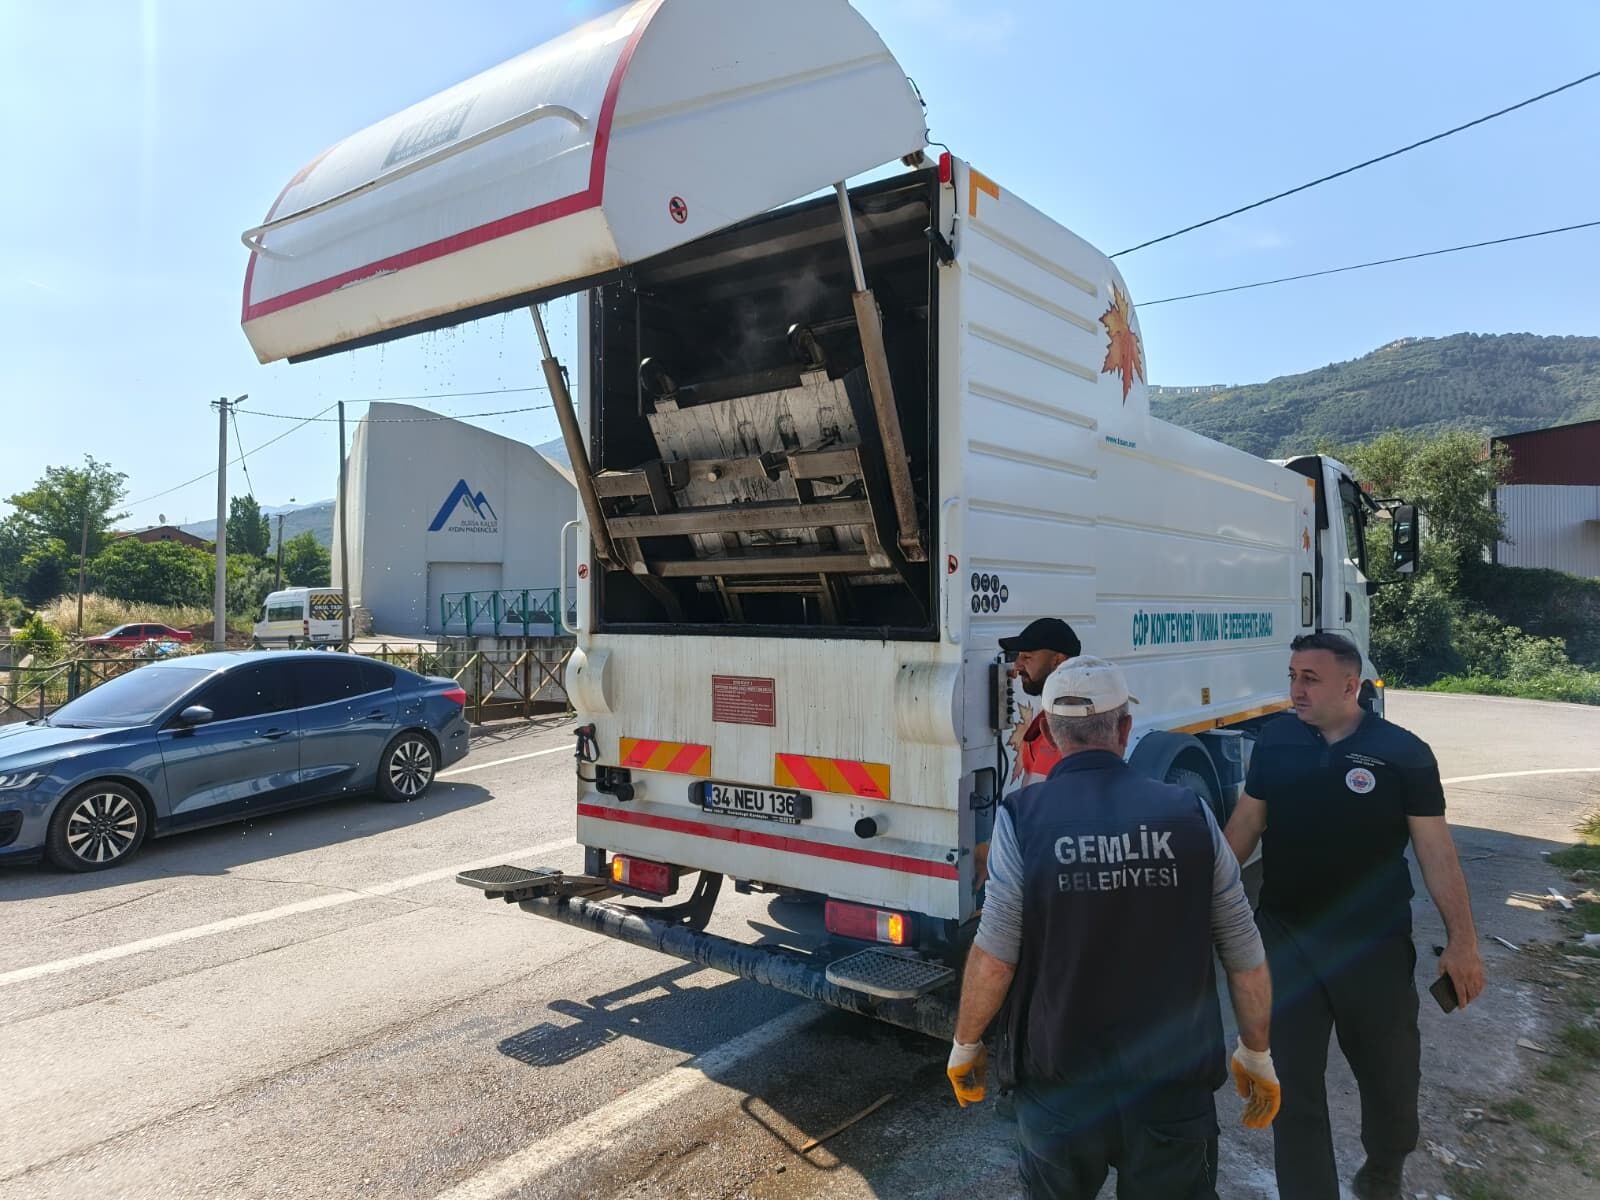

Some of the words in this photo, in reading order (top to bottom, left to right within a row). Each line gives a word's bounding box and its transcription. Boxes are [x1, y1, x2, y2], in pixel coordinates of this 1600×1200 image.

[1132, 608, 1149, 651] ÇÖP
[1150, 609, 1195, 645] KONTEYNERİ
[1220, 612, 1228, 640] VE
[712, 786, 731, 808] 34
[734, 788, 765, 811] NEU
[769, 793, 795, 816] 136
[1054, 824, 1176, 865] GEMLİK
[1058, 863, 1178, 893] BELEDİYESİ
